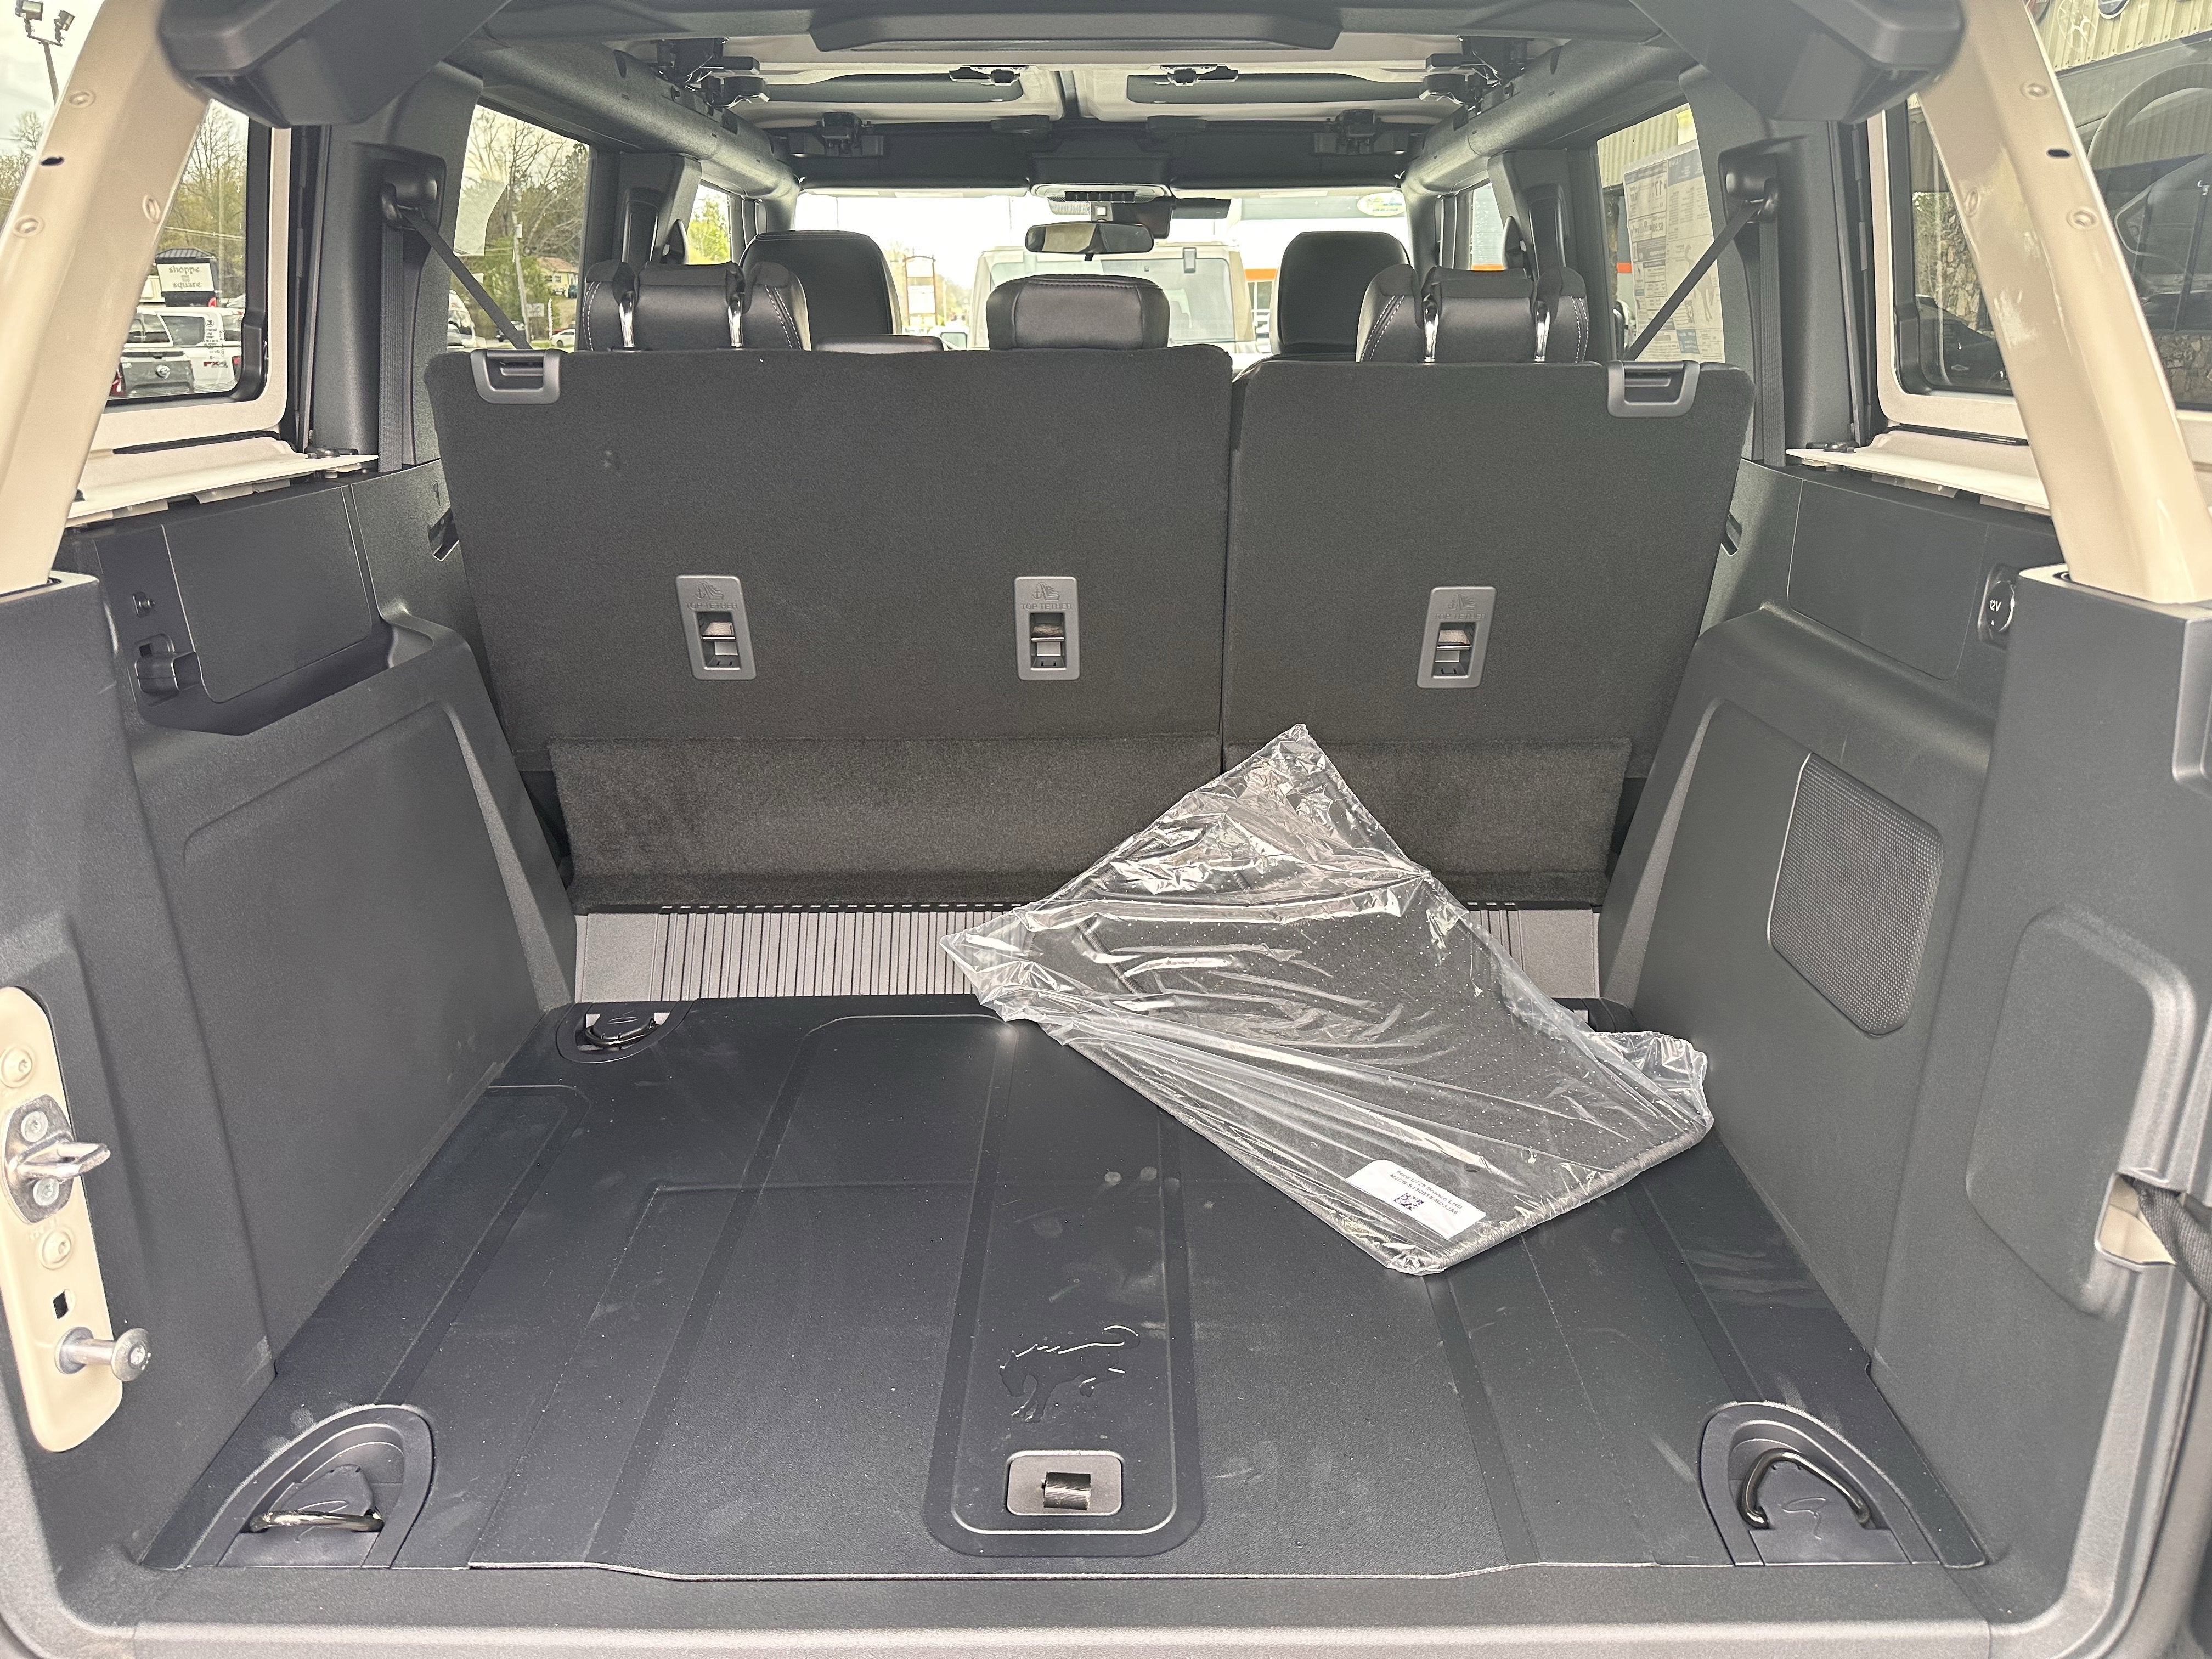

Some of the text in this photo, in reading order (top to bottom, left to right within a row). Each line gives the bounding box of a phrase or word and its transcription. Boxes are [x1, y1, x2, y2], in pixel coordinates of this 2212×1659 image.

[168, 266, 200, 274] shoppe
[172, 281, 201, 290] square
[1990, 600, 2001, 611] 12V
[1396, 1170, 1462, 1209] Ford U725 Bronco LHD
